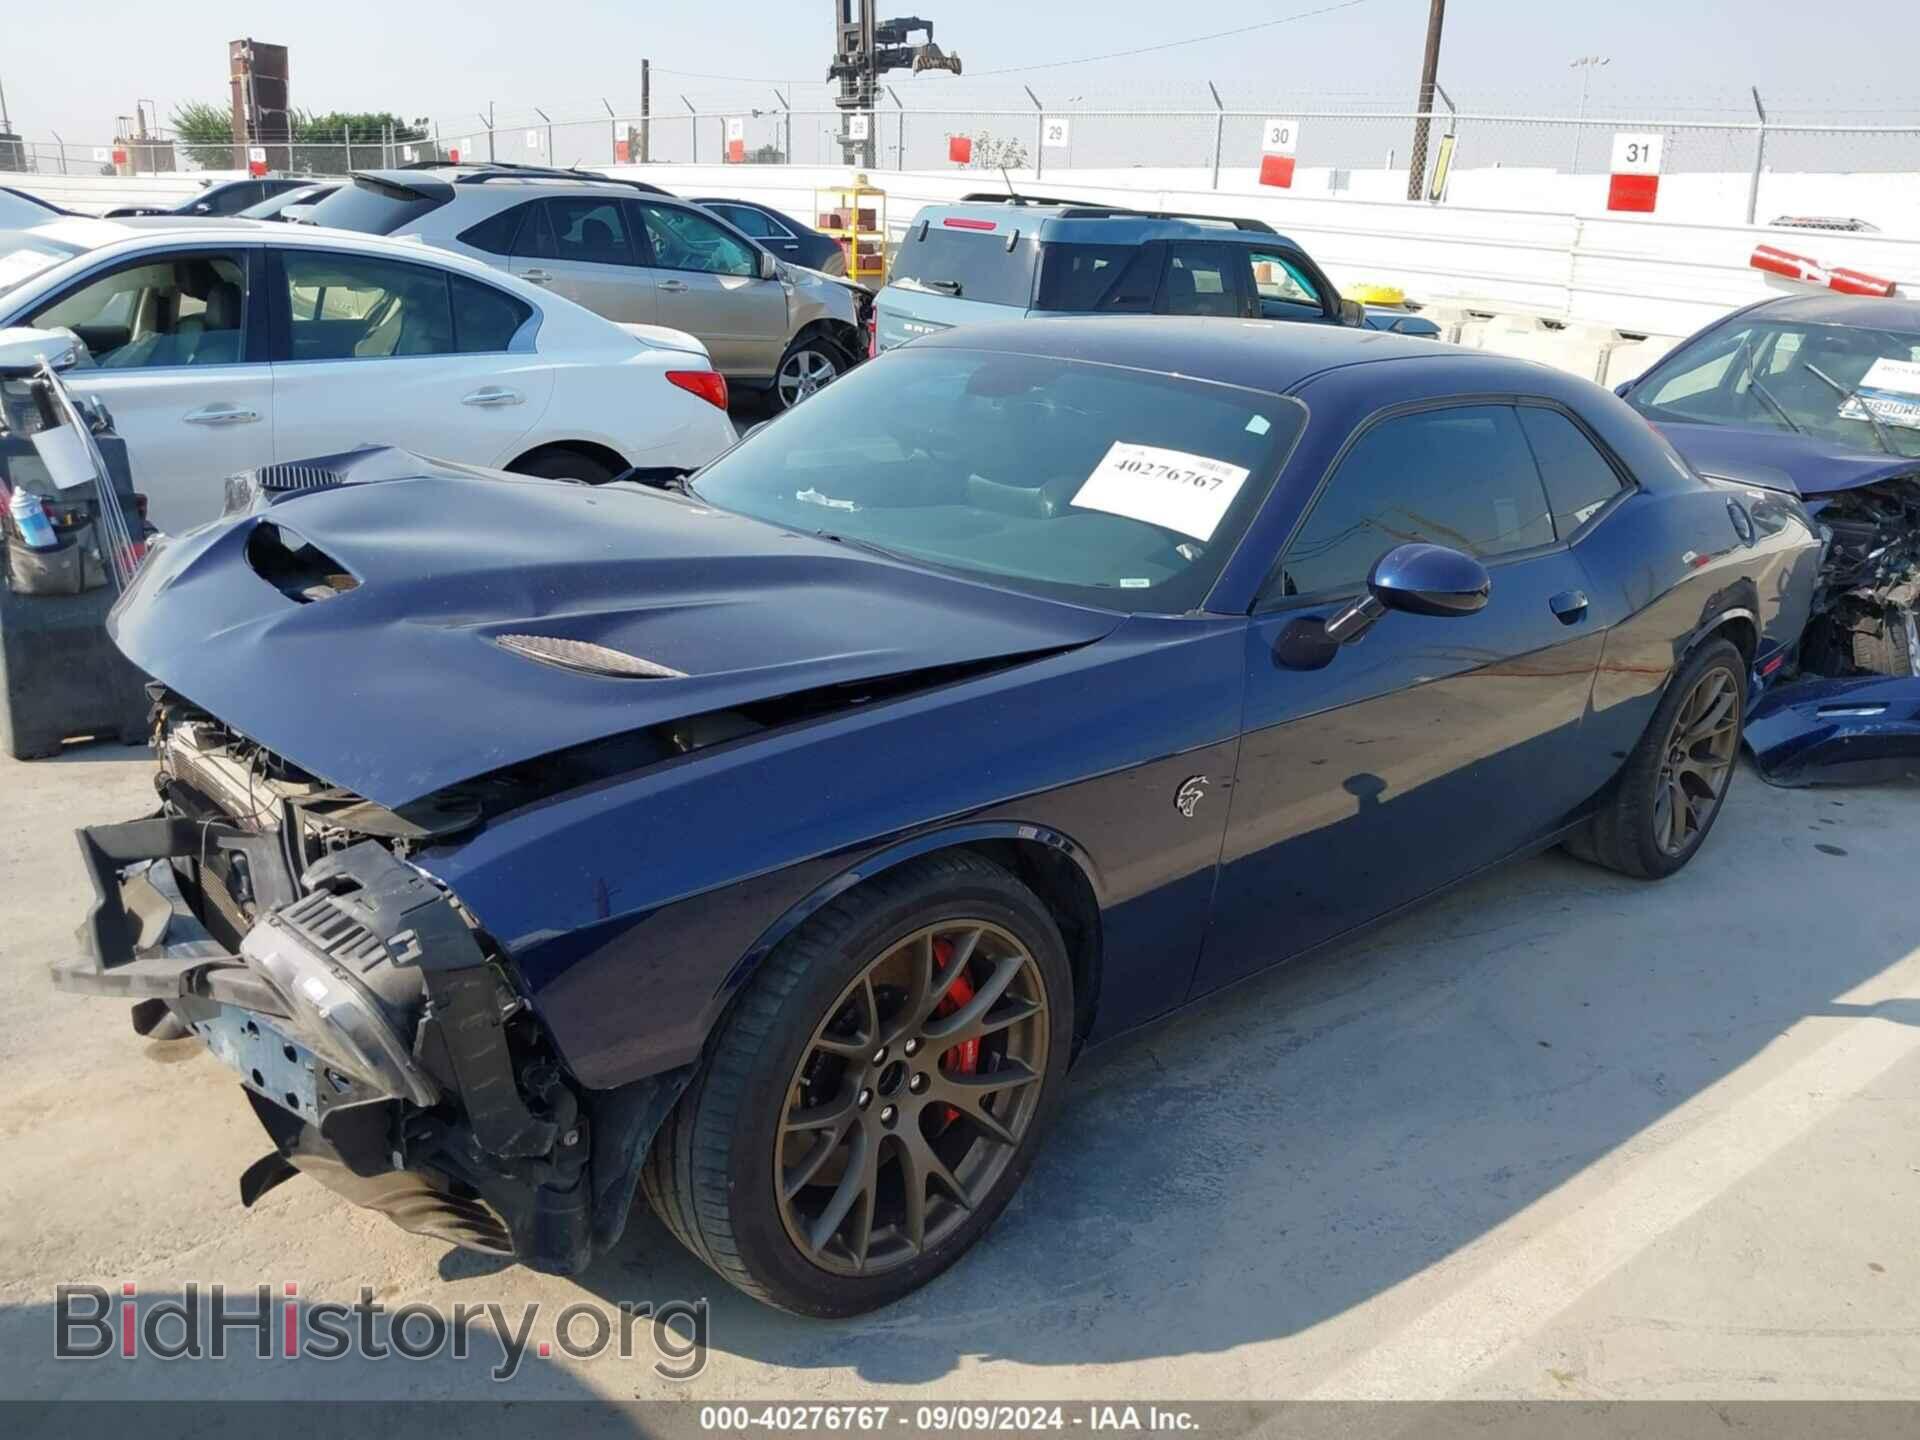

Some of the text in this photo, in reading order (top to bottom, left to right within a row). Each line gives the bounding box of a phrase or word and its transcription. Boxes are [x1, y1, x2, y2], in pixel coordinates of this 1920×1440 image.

[1049, 126, 1062, 140] 29
[1271, 127, 1289, 144] 30
[1626, 143, 1649, 163] 31
[1113, 459, 1224, 491] 40276767
